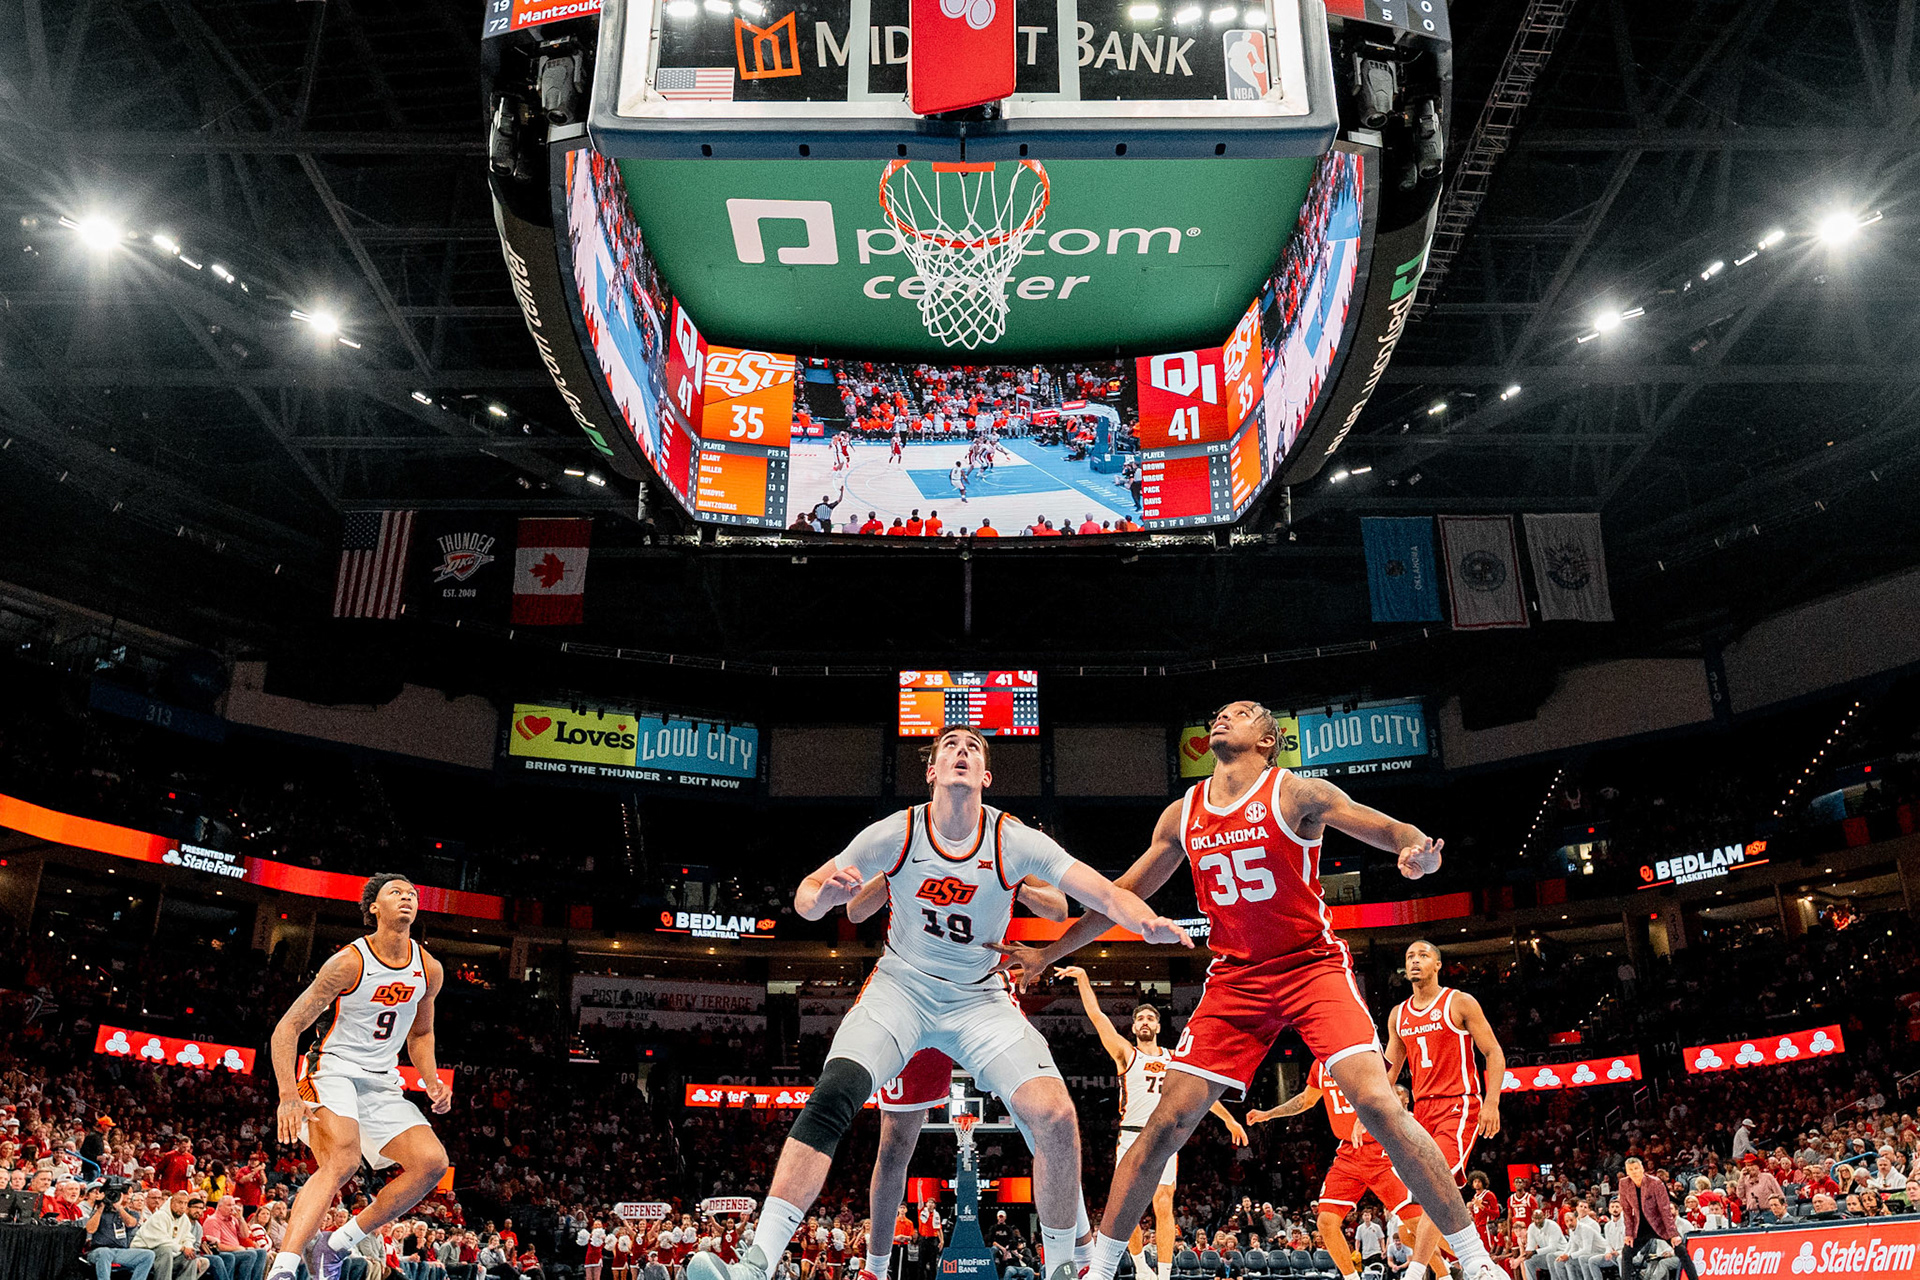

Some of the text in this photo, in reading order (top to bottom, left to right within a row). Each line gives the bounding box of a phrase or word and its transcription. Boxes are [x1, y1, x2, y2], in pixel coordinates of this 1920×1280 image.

[493, 0, 510, 12] 19
[1421, 1, 1432, 13] 0
[489, 18, 508, 32] 72
[1382, 9, 1435, 31] 5 0
[1233, 87, 1255, 100] NBA
[863, 274, 1090, 300] center
[1362, 290, 1414, 394] paycom
[677, 374, 693, 418] 41
[1237, 372, 1254, 420] 35
[729, 404, 764, 440] 35
[1168, 406, 1200, 441] 41
[702, 454, 721, 462] CLARY
[703, 442, 788, 458] PLAYER PTS FL
[1142, 451, 1165, 460] PLAYER
[1220, 444, 1228, 452] FL
[700, 465, 722, 474] MILLER
[1142, 462, 1165, 471] BROWN
[698, 488, 725, 498] VUKOVIC
[1144, 486, 1160, 494] PACK
[698, 500, 737, 511] MANTZOUKAS
[1144, 497, 1162, 506] DAVIS
[702, 512, 710, 520] TO
[722, 514, 730, 522] TF
[1144, 508, 1160, 517] REID
[1194, 516, 1206, 524] 2ND
[437, 532, 496, 554] THUNDER
[443, 589, 476, 598] EST. 2008
[924, 674, 943, 686] 35
[996, 674, 1013, 686] 41
[146, 704, 173, 727] 313
[1305, 716, 1362, 760] LOUD
[1370, 714, 1420, 748] CITY
[642, 728, 752, 770] LOUD CITY
[525, 760, 740, 789] BRING THE THUNDER EXIT NOW
[1293, 760, 1413, 779] NDER EXIT NOW
[1246, 801, 1267, 822] SEC
[1191, 826, 1269, 851] OKLAHOMA
[181, 844, 236, 863] PRESENTED BY
[1656, 843, 1745, 880] BEDLAM
[1198, 846, 1277, 906] 35
[1676, 866, 1728, 885] BASKETBALL
[915, 876, 979, 906] OSU
[676, 912, 756, 934] BEDLAM
[922, 908, 974, 944] 19
[692, 929, 740, 940] BASKETBALL
[370, 982, 416, 1006] OSU
[592, 989, 619, 1003] POST
[661, 994, 698, 1008] PARTY
[701, 994, 753, 1010] TERRACE
[373, 1011, 398, 1040] 9
[606, 1011, 624, 1021] POST
[705, 1016, 721, 1026] POST
[1401, 1022, 1443, 1037] OKLAHOMA
[1416, 1036, 1433, 1068] 1
[1654, 1041, 1678, 1058] 112
[623, 1198, 748, 1216] DEFENSE DEFENSE
[1514, 1207, 1526, 1218] 12
